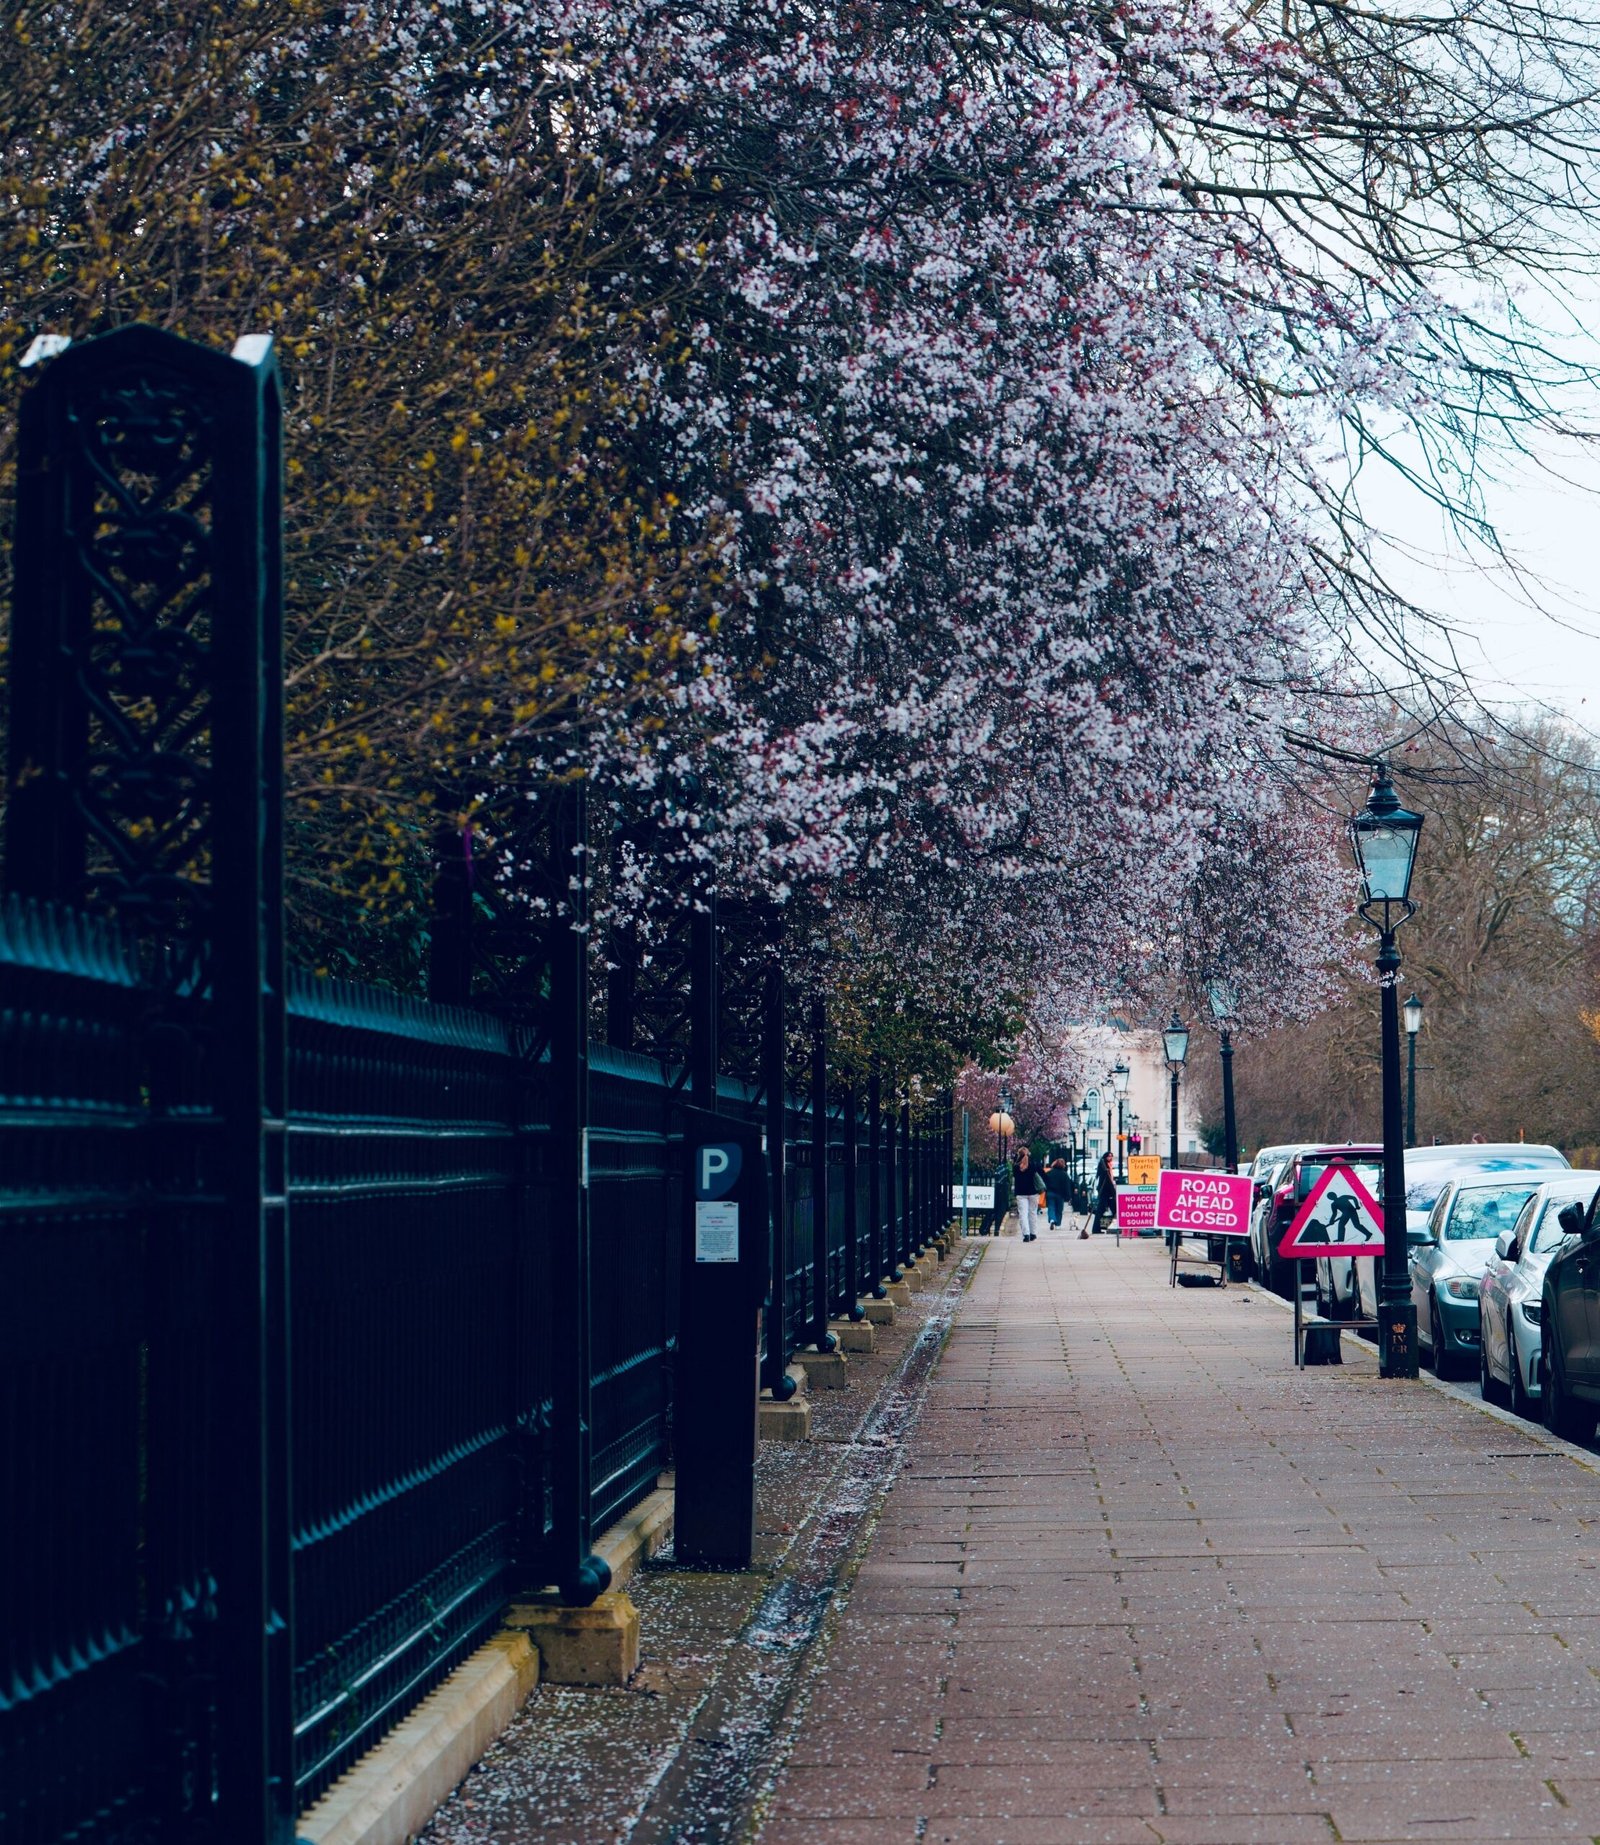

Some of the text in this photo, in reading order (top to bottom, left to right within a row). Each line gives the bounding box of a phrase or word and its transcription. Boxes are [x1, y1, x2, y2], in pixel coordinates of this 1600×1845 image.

[702, 1148, 729, 1190] P
[1181, 1178, 1231, 1195] ROAD
[1175, 1194, 1234, 1211] AHEAD
[1169, 1209, 1238, 1227] CLOSED
